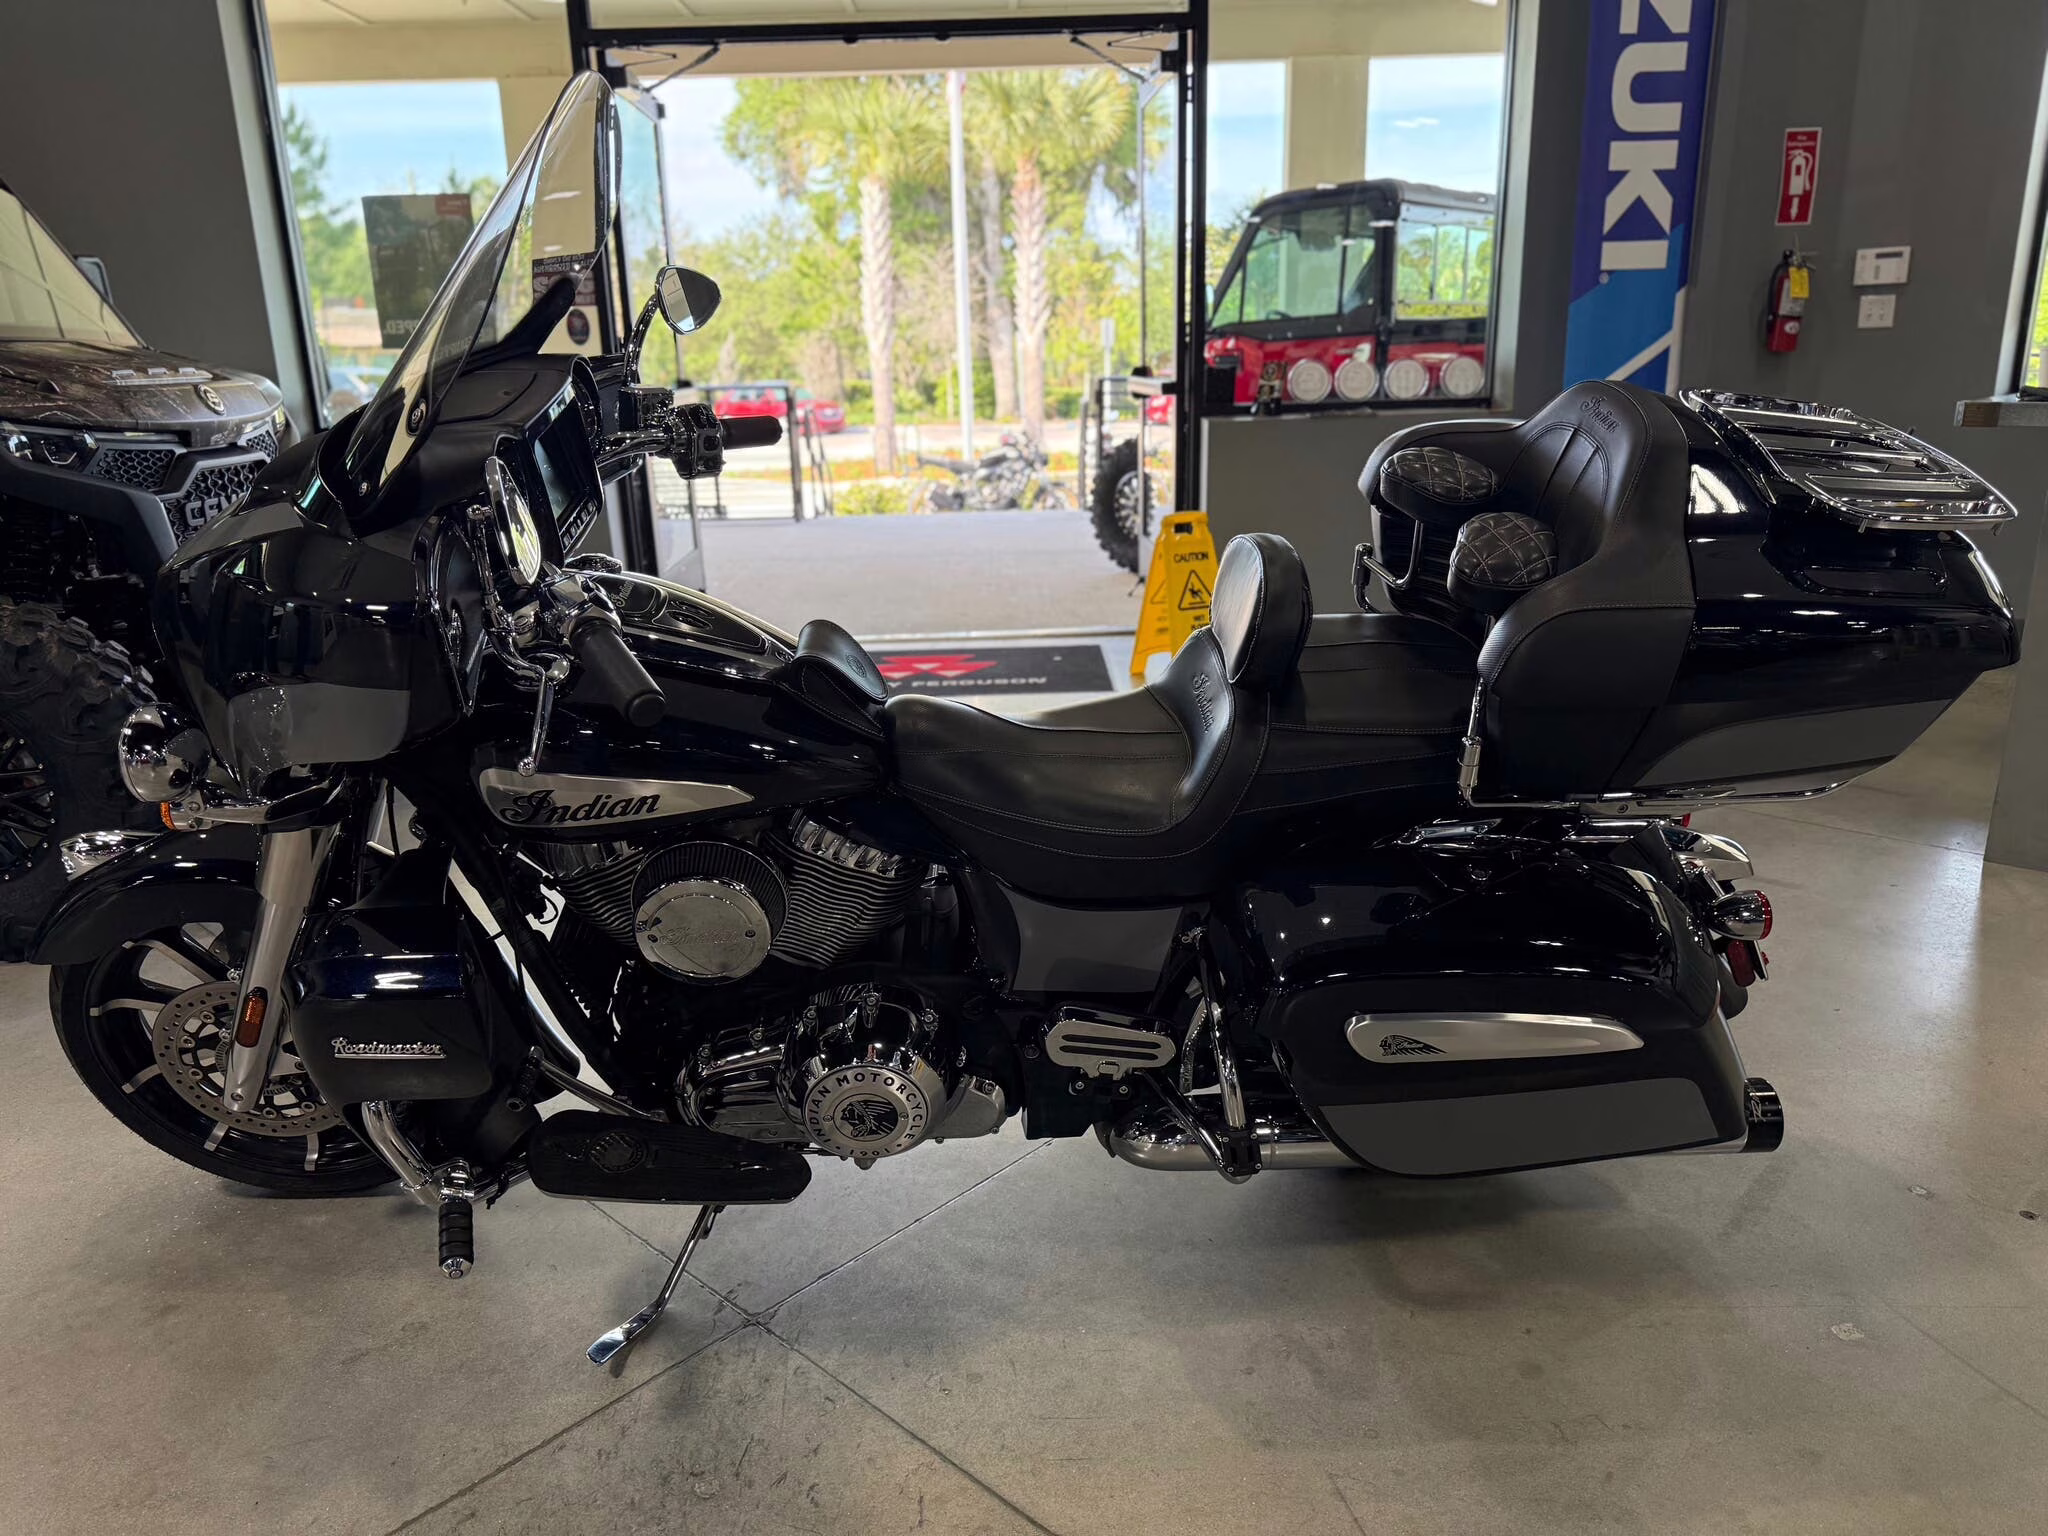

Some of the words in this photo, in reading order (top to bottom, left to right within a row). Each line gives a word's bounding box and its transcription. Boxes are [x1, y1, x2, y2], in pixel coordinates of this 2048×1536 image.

[1173, 551, 1209, 563] CAUTION
[611, 580, 635, 607] Indian
[911, 676, 1047, 688] FERGUSON
[500, 789, 660, 825] Indian
[331, 1037, 443, 1055] Roadmaster
[808, 1085, 831, 1143] INDIAN
[835, 1072, 923, 1141] MOTORCYCLE
